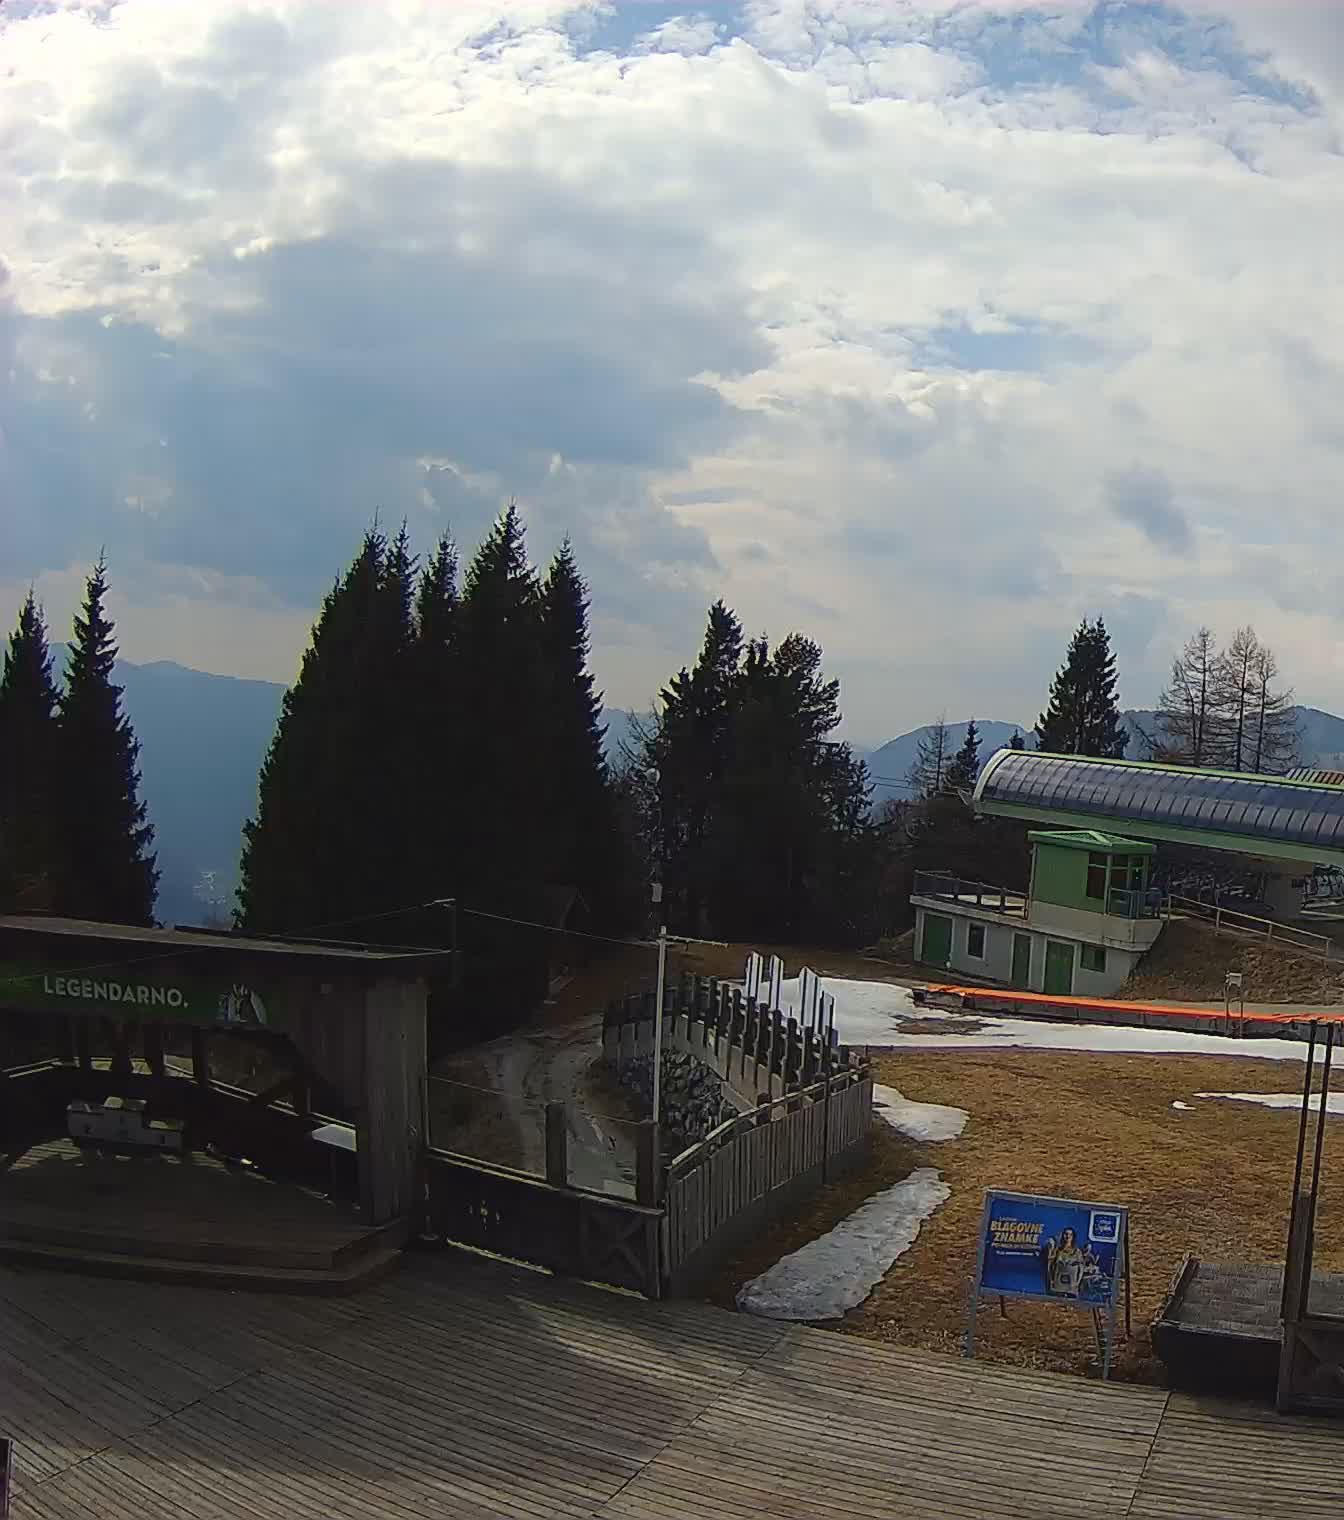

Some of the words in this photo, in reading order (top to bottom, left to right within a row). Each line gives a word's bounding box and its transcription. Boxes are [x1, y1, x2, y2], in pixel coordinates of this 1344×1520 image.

[44, 975, 189, 1009] LEGENDARNO.
[990, 1220, 1045, 1234] BLAGOVNE
[993, 1232, 1040, 1244] ZNAMKE
